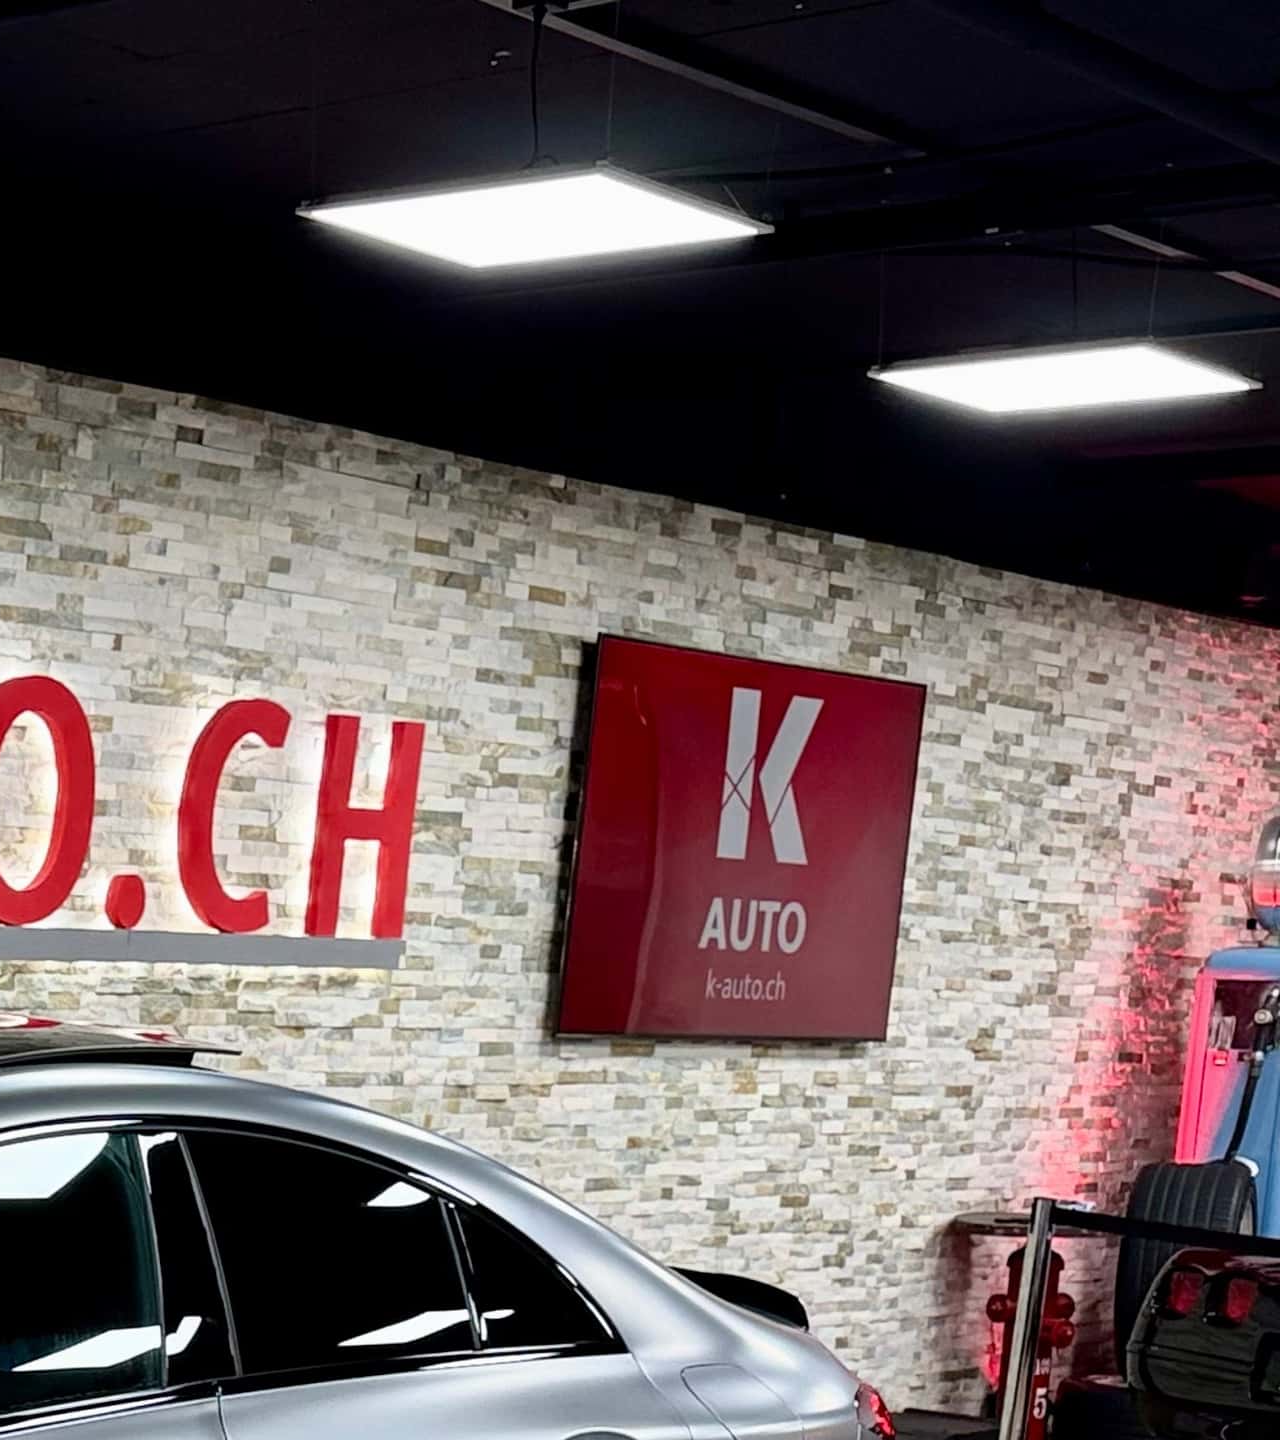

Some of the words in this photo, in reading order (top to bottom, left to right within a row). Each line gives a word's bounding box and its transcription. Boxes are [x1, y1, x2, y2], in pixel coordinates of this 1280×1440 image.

[716, 687, 824, 866] K
[698, 897, 807, 954] AUTO
[705, 969, 786, 1001] k-auto.ch
